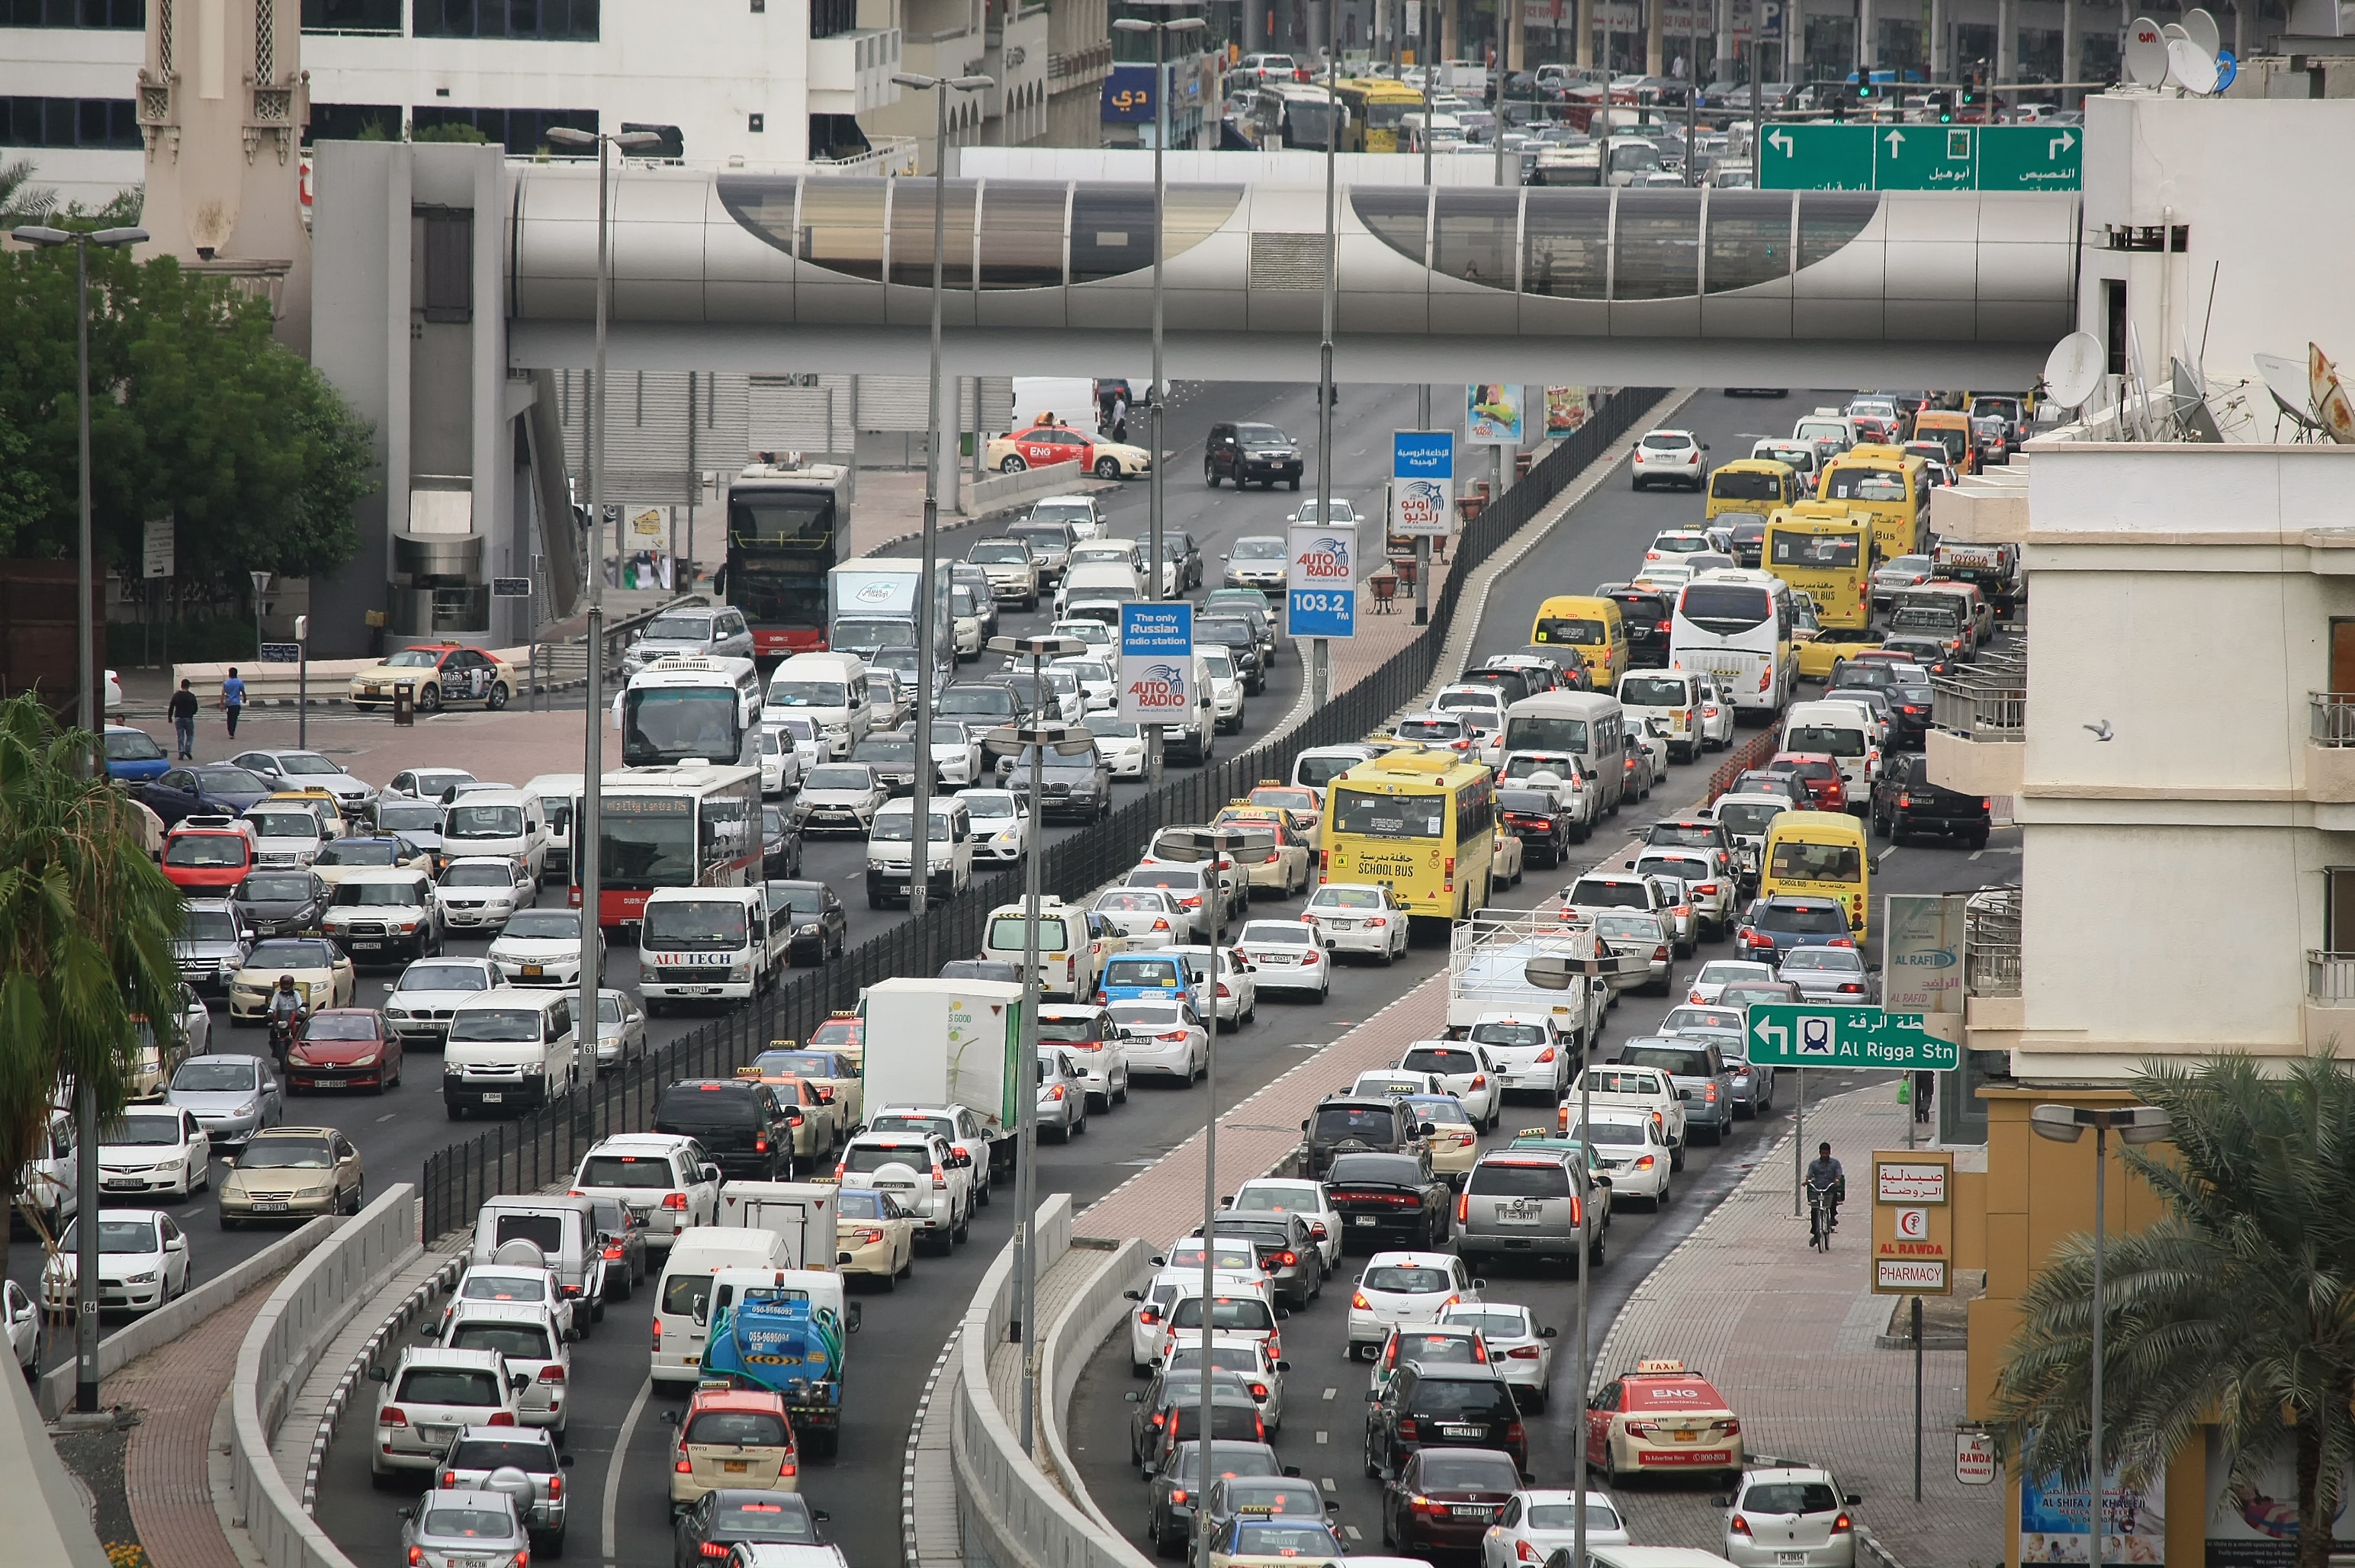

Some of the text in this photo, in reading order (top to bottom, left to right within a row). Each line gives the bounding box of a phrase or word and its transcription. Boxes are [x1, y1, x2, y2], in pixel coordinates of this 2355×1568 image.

[1030, 446, 1051, 457] ENG
[1875, 531, 1895, 541] Bus
[1296, 553, 1334, 565] AUTO
[1306, 565, 1349, 577] RADIO
[1293, 593, 1345, 612] 103.2
[1135, 613, 1177, 623] The only
[1130, 624, 1178, 634] Russian
[1127, 682, 1169, 694] AUTO
[1139, 694, 1185, 706] RADIO
[1360, 851, 1413, 863] حافلة مدرسية
[1358, 863, 1413, 877] SCHOOL BUS
[1895, 956, 1907, 966] AL
[1891, 994, 1927, 1003] AL RAFID
[954, 1014, 971, 1023] GOOD
[1848, 1013, 1888, 1033] الرقة
[1839, 1042, 1953, 1061] Al Rigga Stn
[1881, 1169, 1943, 1184] صيدلية
[1881, 1186, 1942, 1197] الروضة
[1015, 1235, 1023, 1243] 85
[1880, 1244, 1943, 1255] AL RAWDA
[1880, 1267, 1942, 1281] PHARMACY
[85, 1303, 95, 1313] 64
[1652, 1389, 1698, 1399] ENG
[1461, 1427, 1481, 1436] 47919
[1971, 1440, 1981, 1451] AL
[1960, 1452, 1991, 1464] RAWDA
[1959, 1467, 1991, 1476] PHARMACY
[2042, 1499, 2054, 1507] AL
[2058, 1499, 2084, 1508] SHIFA
